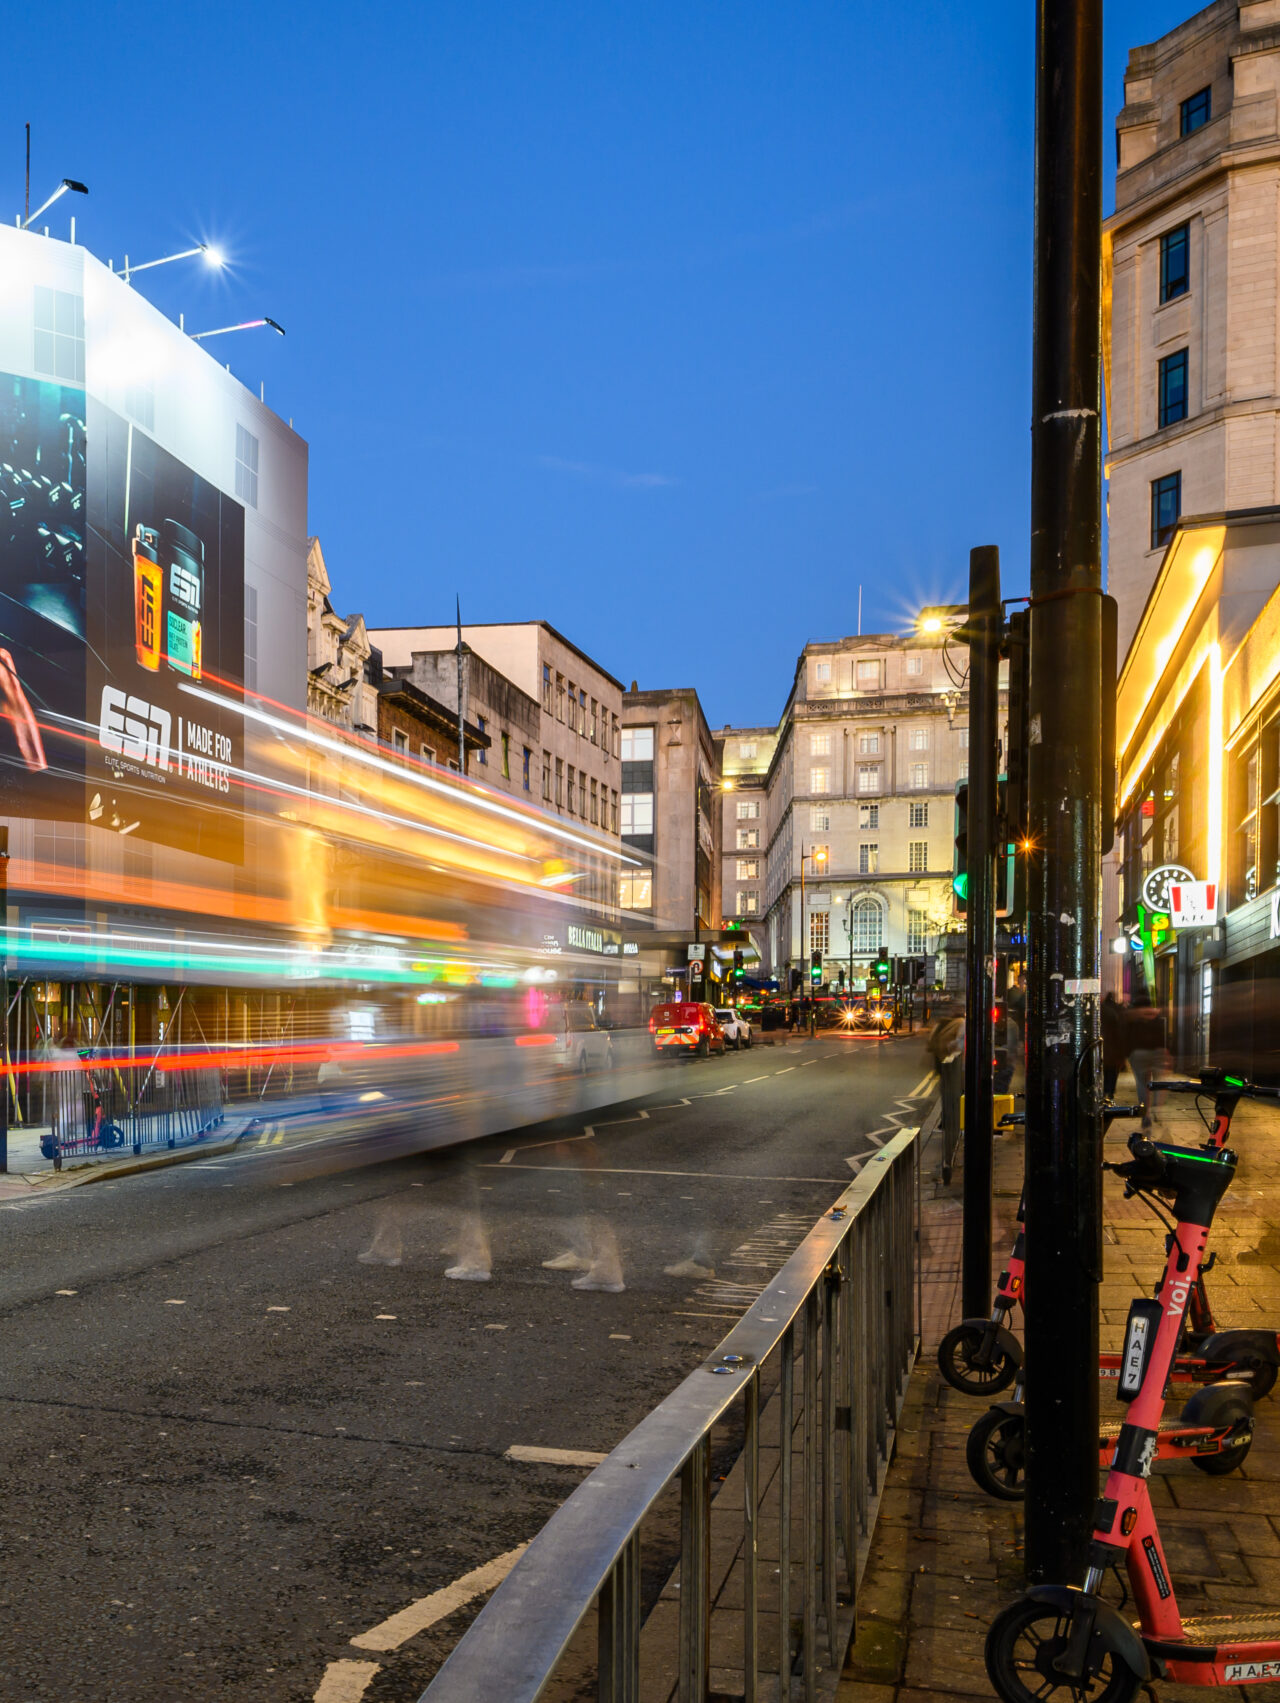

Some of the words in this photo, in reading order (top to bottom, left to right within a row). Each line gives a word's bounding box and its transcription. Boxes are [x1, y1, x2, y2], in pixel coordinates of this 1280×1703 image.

[187, 720, 213, 756] MADE
[215, 732, 232, 763] FOR
[104, 755, 119, 769] ELITE
[120, 761, 140, 775] SPORTS
[141, 767, 166, 784] NUTRITION
[187, 755, 230, 794] ATHLETES
[568, 925, 586, 949] BELLA
[586, 930, 603, 953] ITALIA
[1167, 1276, 1191, 1316] voi.
